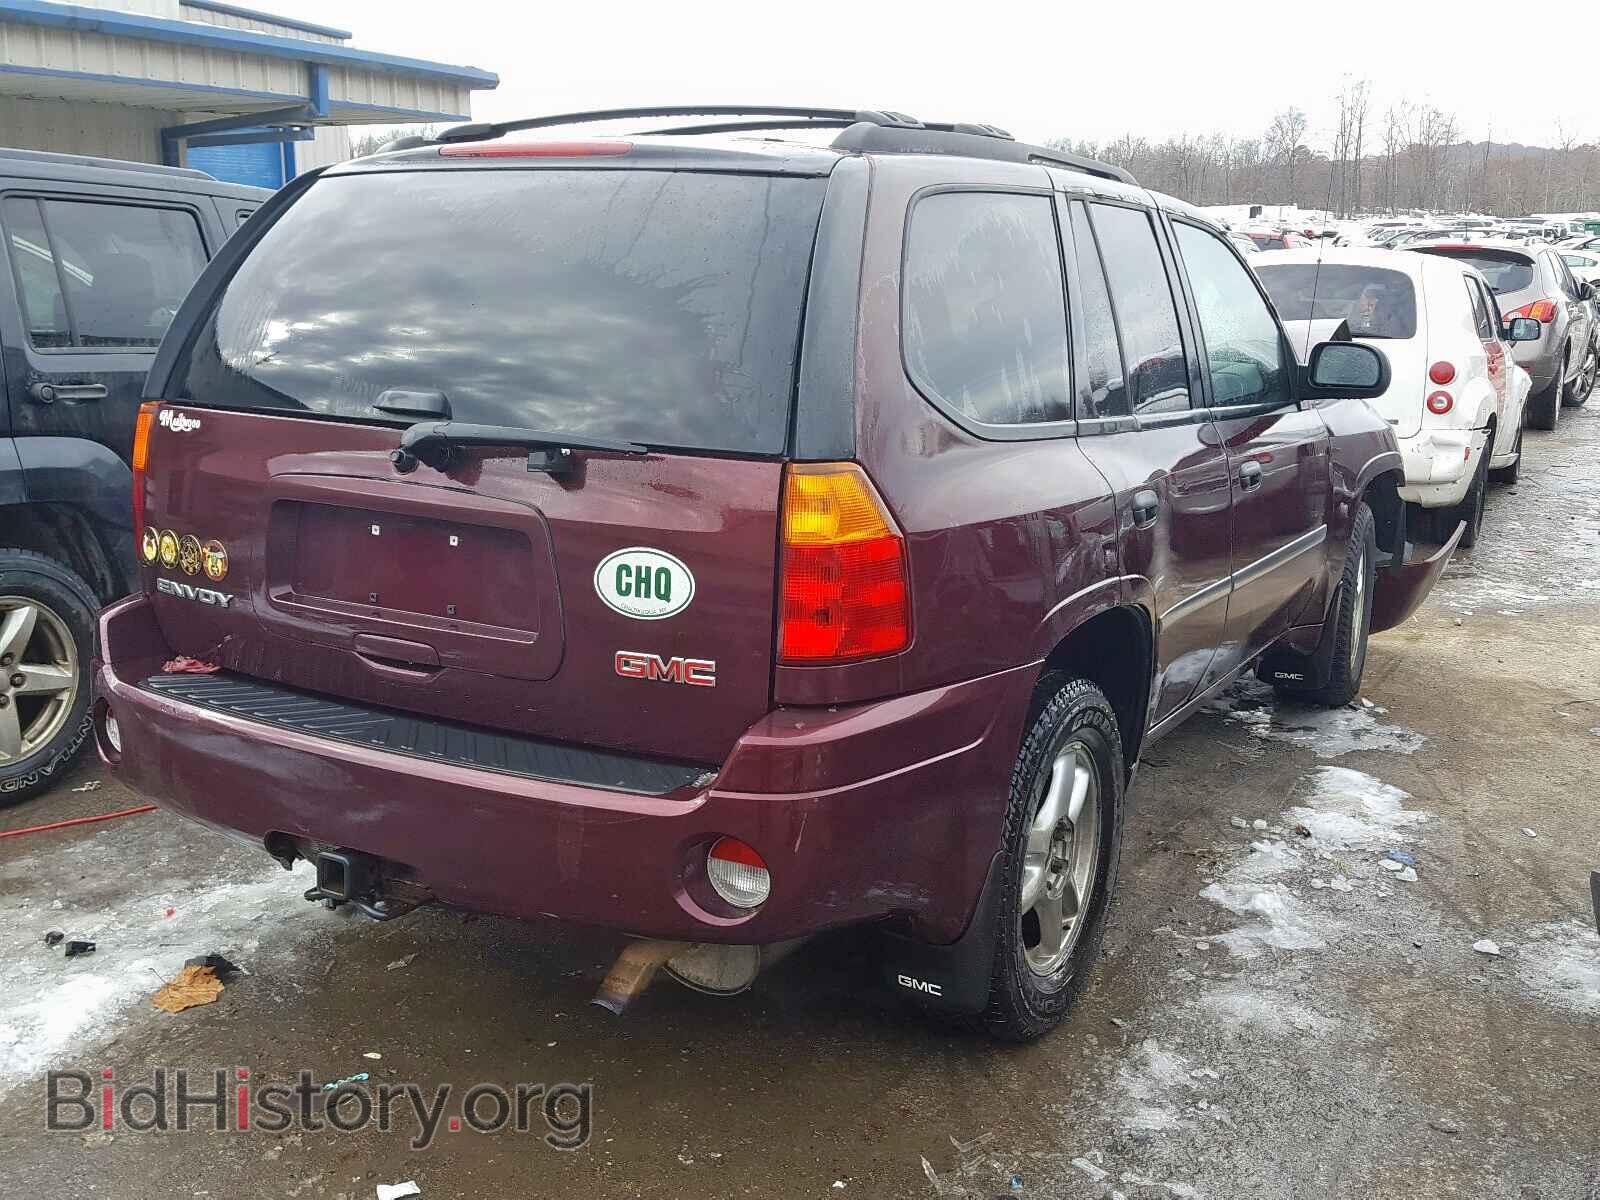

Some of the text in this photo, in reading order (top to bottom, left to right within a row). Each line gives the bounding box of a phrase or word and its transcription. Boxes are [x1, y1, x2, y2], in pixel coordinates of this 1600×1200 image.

[156, 577, 234, 608] ENVOY
[615, 563, 672, 603] CHQ
[614, 650, 716, 688] GMC
[1274, 671, 1304, 681] GMC
[897, 974, 943, 997] GMC
